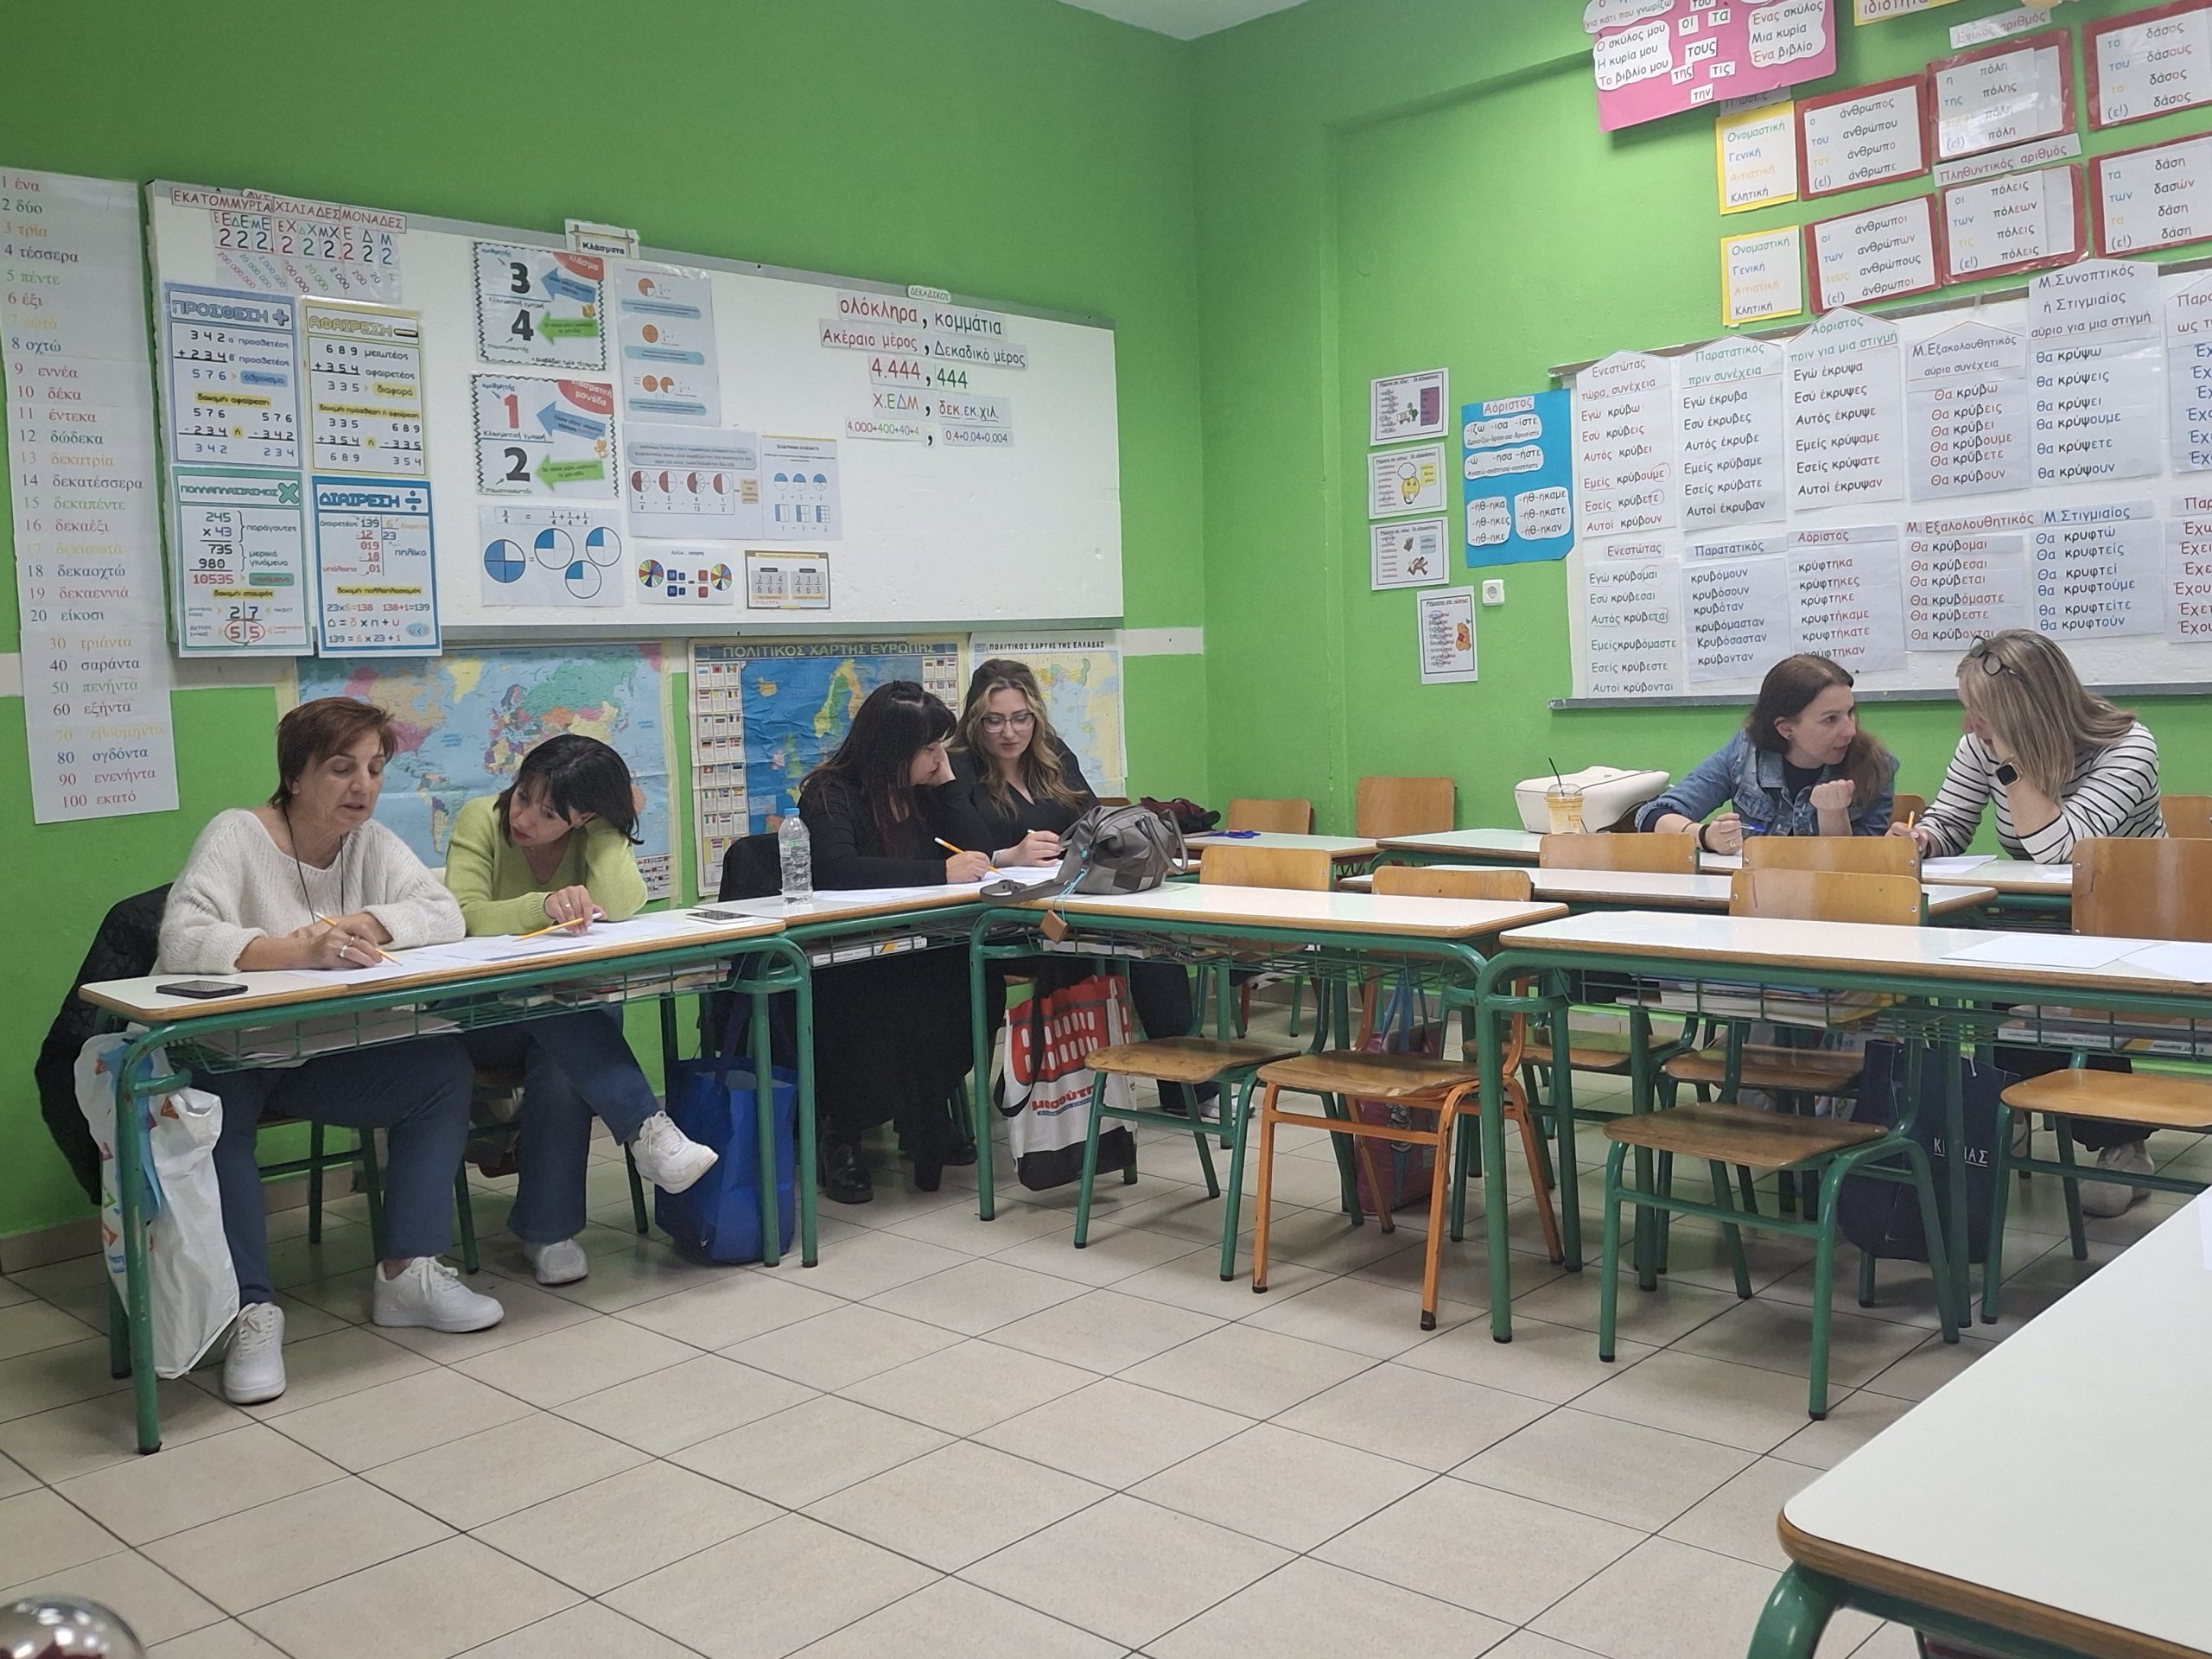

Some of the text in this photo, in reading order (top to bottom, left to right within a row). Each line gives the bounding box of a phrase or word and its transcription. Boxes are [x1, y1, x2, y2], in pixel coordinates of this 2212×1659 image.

[1713, 11, 1728, 22] τα
[1783, 3, 1822, 18] σκύλος
[1682, 19, 1694, 29] οι
[2146, 22, 2183, 39] δάσος
[1609, 30, 1643, 48] σκύλος
[1648, 24, 1665, 37] μου
[1752, 23, 1807, 44] Μια κυρία
[1688, 41, 1716, 55] τους
[1778, 41, 1812, 58] βιβλίο
[2147, 44, 2191, 62] δάσους
[1610, 51, 1637, 67] κυρία
[1639, 46, 1657, 58] μου
[1599, 60, 1669, 86] Το βιβλίο μου
[1675, 67, 1693, 80] της
[1713, 65, 1731, 76] τις
[1694, 90, 1711, 101] την
[1983, 83, 2017, 98] πόλης
[1840, 99, 1894, 119] άνθρωπος
[1728, 121, 1785, 142] Ονομαστική
[1812, 119, 1897, 146] του ανθρώπου
[1729, 149, 1761, 162] Γενική
[1847, 142, 1895, 160] άνθρωπο
[1940, 145, 2067, 182] Πληθυντικός αριθμός
[2155, 158, 2185, 171] δάση
[1732, 187, 1769, 202] Κλητική
[1991, 181, 2029, 197] πόλεις
[2154, 179, 2194, 194] δασών
[2, 199, 42, 214] 2 δύο
[174, 191, 403, 228] ΕΚΑΤΟΜΜΥΡΙΑ ΧΙΛΙΑΔΕΣ ΜΟΝΑΔΕΣ
[1993, 201, 2037, 219] πόλεων
[5, 245, 79, 263] 4 τέσσερα
[582, 242, 624, 254] Κλάσματα
[1824, 234, 1915, 263] των ανθρώπων
[1860, 254, 1921, 276] ανθρώπους
[510, 262, 531, 294] 3
[9, 293, 42, 308] 6 έξι
[911, 288, 949, 301] ΔΕΚΑΔΙΚΟΙ
[2056, 292, 2126, 312] Στιγμιαίος
[512, 309, 534, 341] 4
[935, 313, 1001, 334] κομμάτια
[1812, 317, 1863, 334] Αόριστος
[2031, 312, 2151, 338] αύριο για μια στιγμή
[12, 338, 61, 355] 8 οχτώ
[823, 329, 875, 346] Ακέραιο
[935, 340, 989, 361] Δεκαδικό
[995, 351, 1025, 367] μέρος
[1695, 343, 1764, 362] Παρατατικός
[2058, 347, 2101, 363] κρύψω
[16, 363, 78, 378] 9 εννέα
[1592, 359, 1645, 378] Ενεστώτας
[1688, 365, 1762, 385] πριν συνέχεια
[1924, 359, 1999, 377] αύριο συνέχεια
[18, 386, 81, 401] 10 δέκα
[1684, 390, 1747, 409] Εγώ έκρυβα
[1795, 385, 1867, 404] Εσύ έκρυψες
[1935, 384, 1998, 401] Θα κρύβω
[504, 394, 518, 429] 1
[1484, 397, 1532, 415] Αόριστος
[1581, 404, 1640, 422] Εγώ κρύβω
[19, 408, 96, 423] 11 έντεκα
[21, 429, 103, 444] 12 δώδεκα
[1796, 430, 1879, 451] Εμείς κρύψαμε
[1584, 445, 1652, 462] Αυτός κρύβει
[504, 447, 531, 482] 2
[2060, 463, 2114, 478] κρύψουν
[22, 474, 143, 491] 14 δεκατέσσερα
[320, 493, 399, 508] ΔΙΑΙΡΕΣΗ
[1687, 499, 1764, 517] Αυτοί έκρυβαν
[207, 512, 232, 522] 245
[1798, 530, 1849, 543] Αόριστος
[2037, 528, 2115, 544] Θα κρυφτώ
[208, 544, 232, 554] 735
[1608, 543, 1662, 556] Ενεστώτας
[1695, 541, 1764, 556] Παρατατικός
[1911, 539, 1987, 553] Θα κρύβομαι
[199, 558, 225, 569] 980
[1799, 557, 1853, 572] κρύφτηκα
[2066, 564, 2117, 579] κρυφτεί
[29, 565, 125, 580] 18 δεκαοχτώ
[194, 575, 233, 584] 10535
[1590, 569, 1657, 584] Εγώ κρύβομαι
[1691, 568, 1748, 583] κρυβόμουν
[31, 610, 105, 622] 20 είκοσι
[1694, 601, 1744, 615] κρυβόταν
[1802, 609, 1870, 625] κρυφτήκαμε
[724, 643, 936, 658] ΠΟΛΙΤΙΚΟΣ ΧΑΡΤΗΣ ΕΥΡΩΠΗΣ
[50, 658, 140, 673] 40 σαράντα
[54, 702, 131, 715] 60 εξήντα
[58, 749, 148, 764] 80 ογδόντα
[63, 792, 136, 808] 100 εκατό
